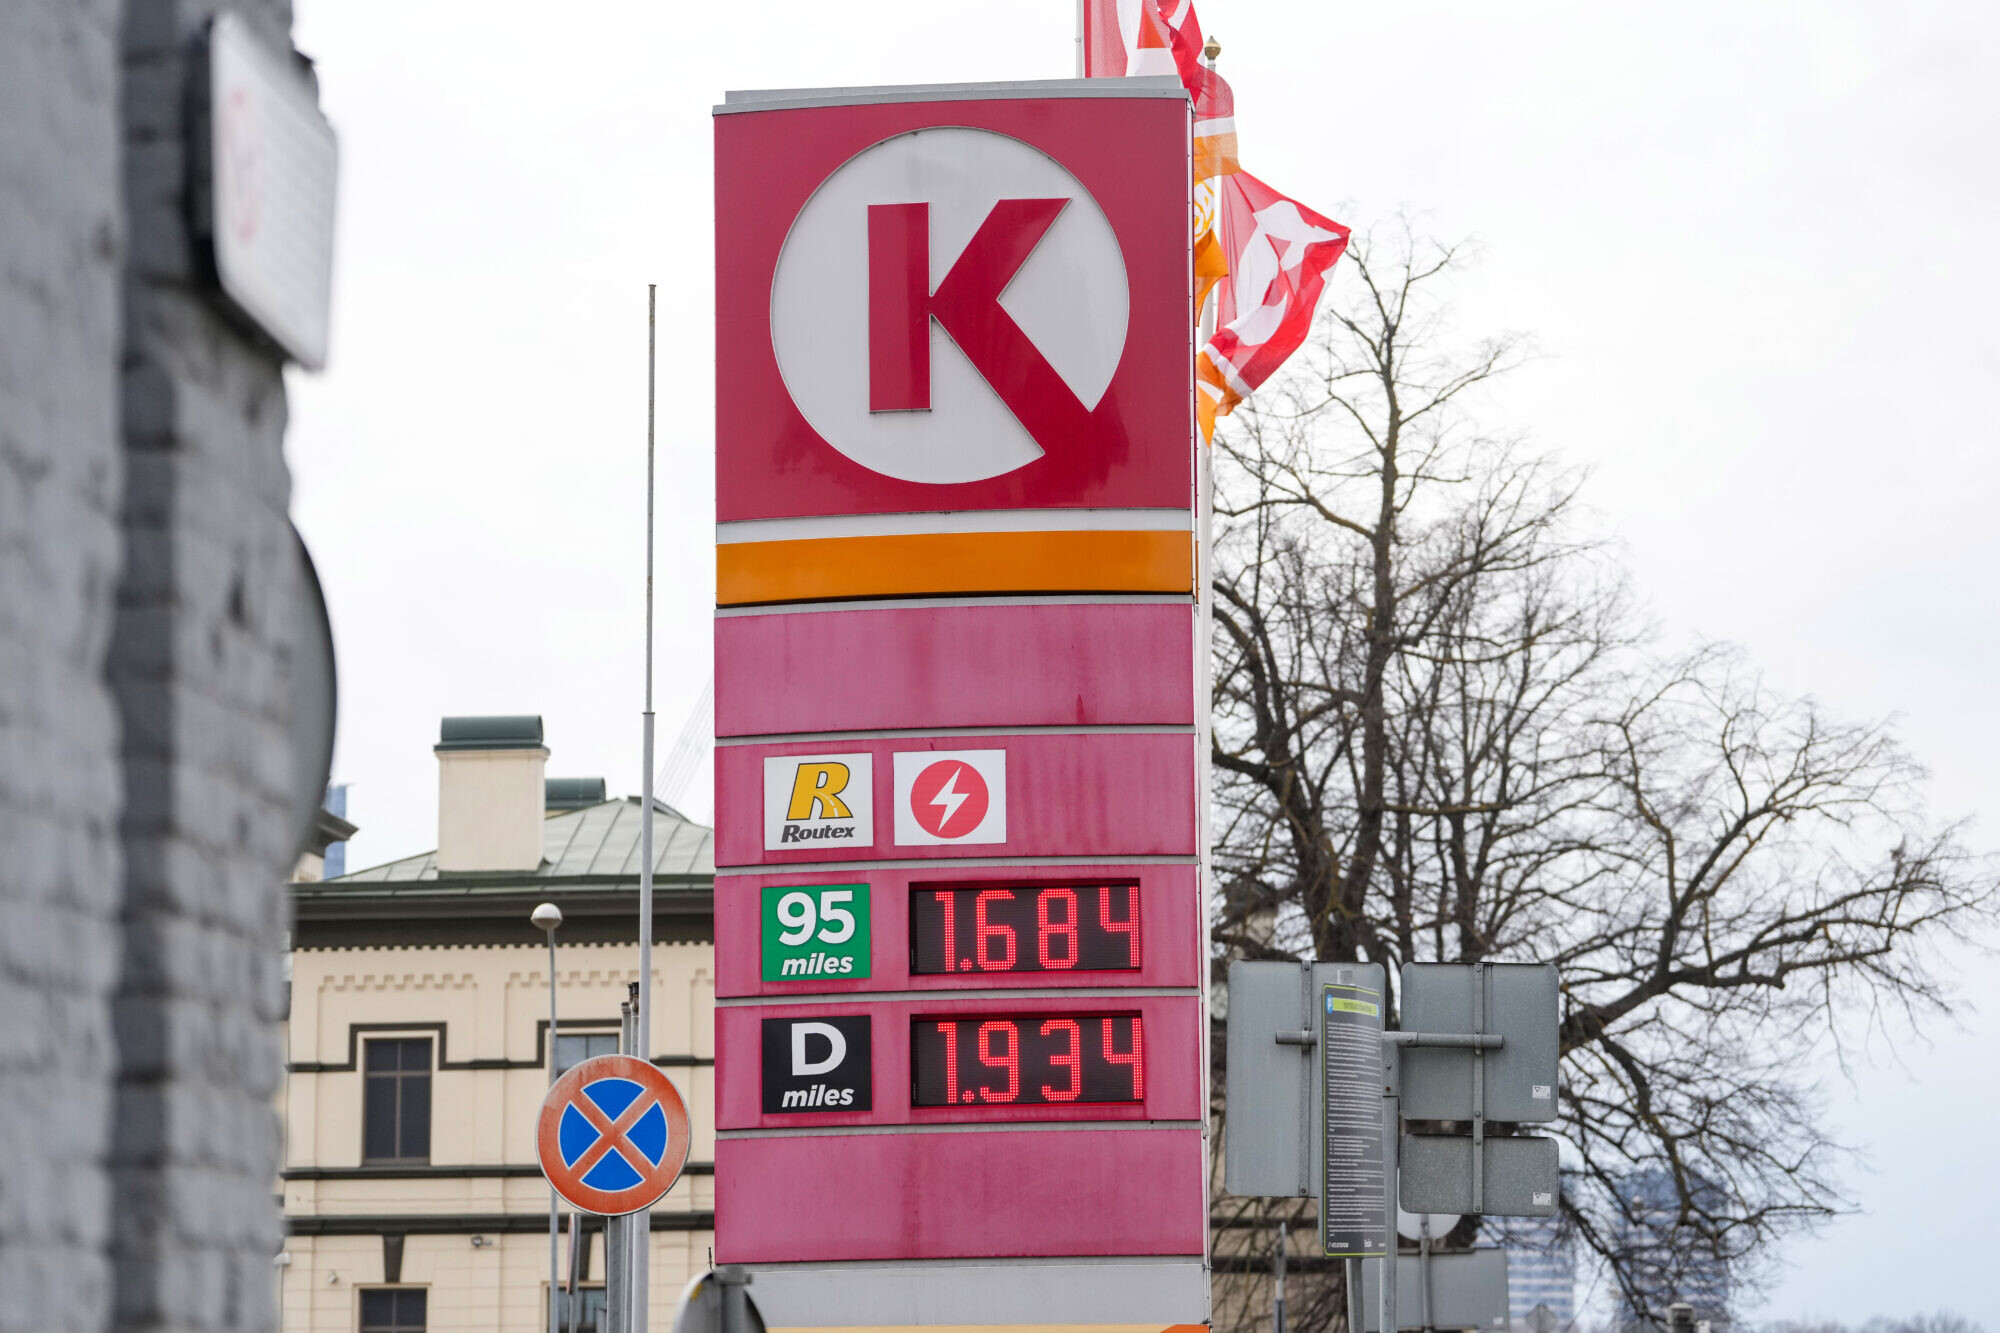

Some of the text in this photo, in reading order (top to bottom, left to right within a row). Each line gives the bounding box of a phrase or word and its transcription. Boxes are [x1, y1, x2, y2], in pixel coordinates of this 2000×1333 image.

[867, 197, 1092, 453] K
[786, 761, 854, 821] R
[781, 824, 855, 843] Routex
[777, 890, 856, 946] 95
[935, 886, 1141, 973] 1.684
[781, 952, 853, 976] miles
[791, 1022, 847, 1076] D
[937, 1018, 1143, 1104] 1.934
[781, 1084, 854, 1108] miles
